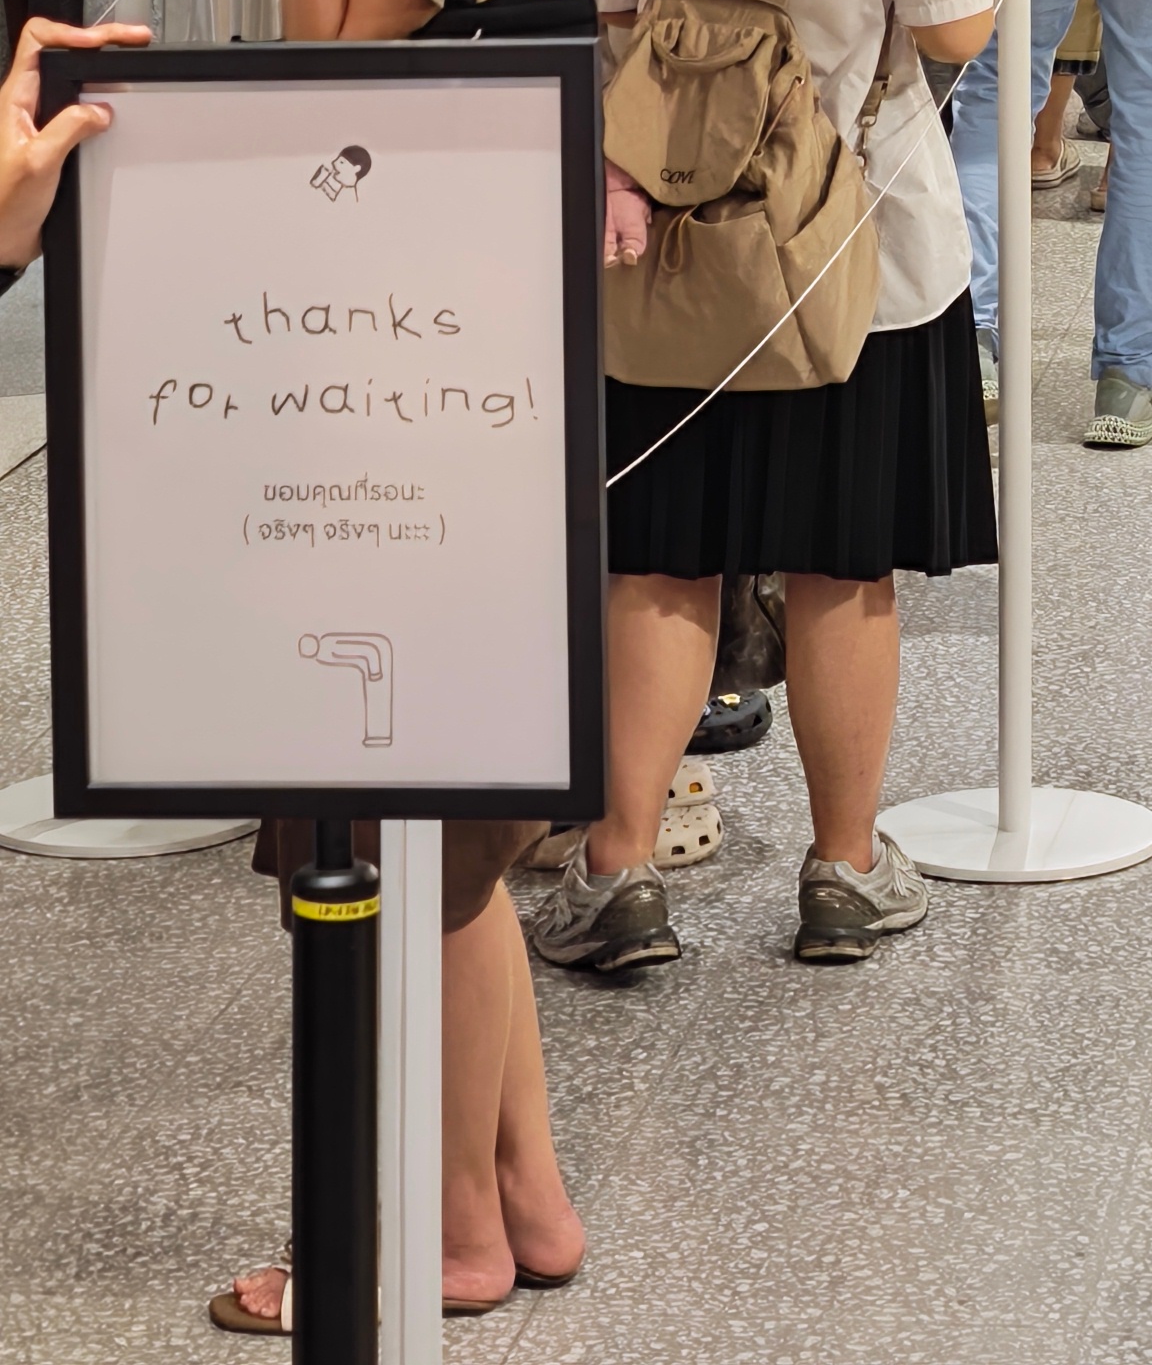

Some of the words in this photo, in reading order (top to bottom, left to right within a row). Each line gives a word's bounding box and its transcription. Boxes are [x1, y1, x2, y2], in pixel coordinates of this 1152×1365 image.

[224, 291, 461, 345] thanks
[148, 378, 239, 426] for
[271, 377, 539, 428] waiting!
[263, 471, 425, 509] ขอบคุณที่รอนะ
